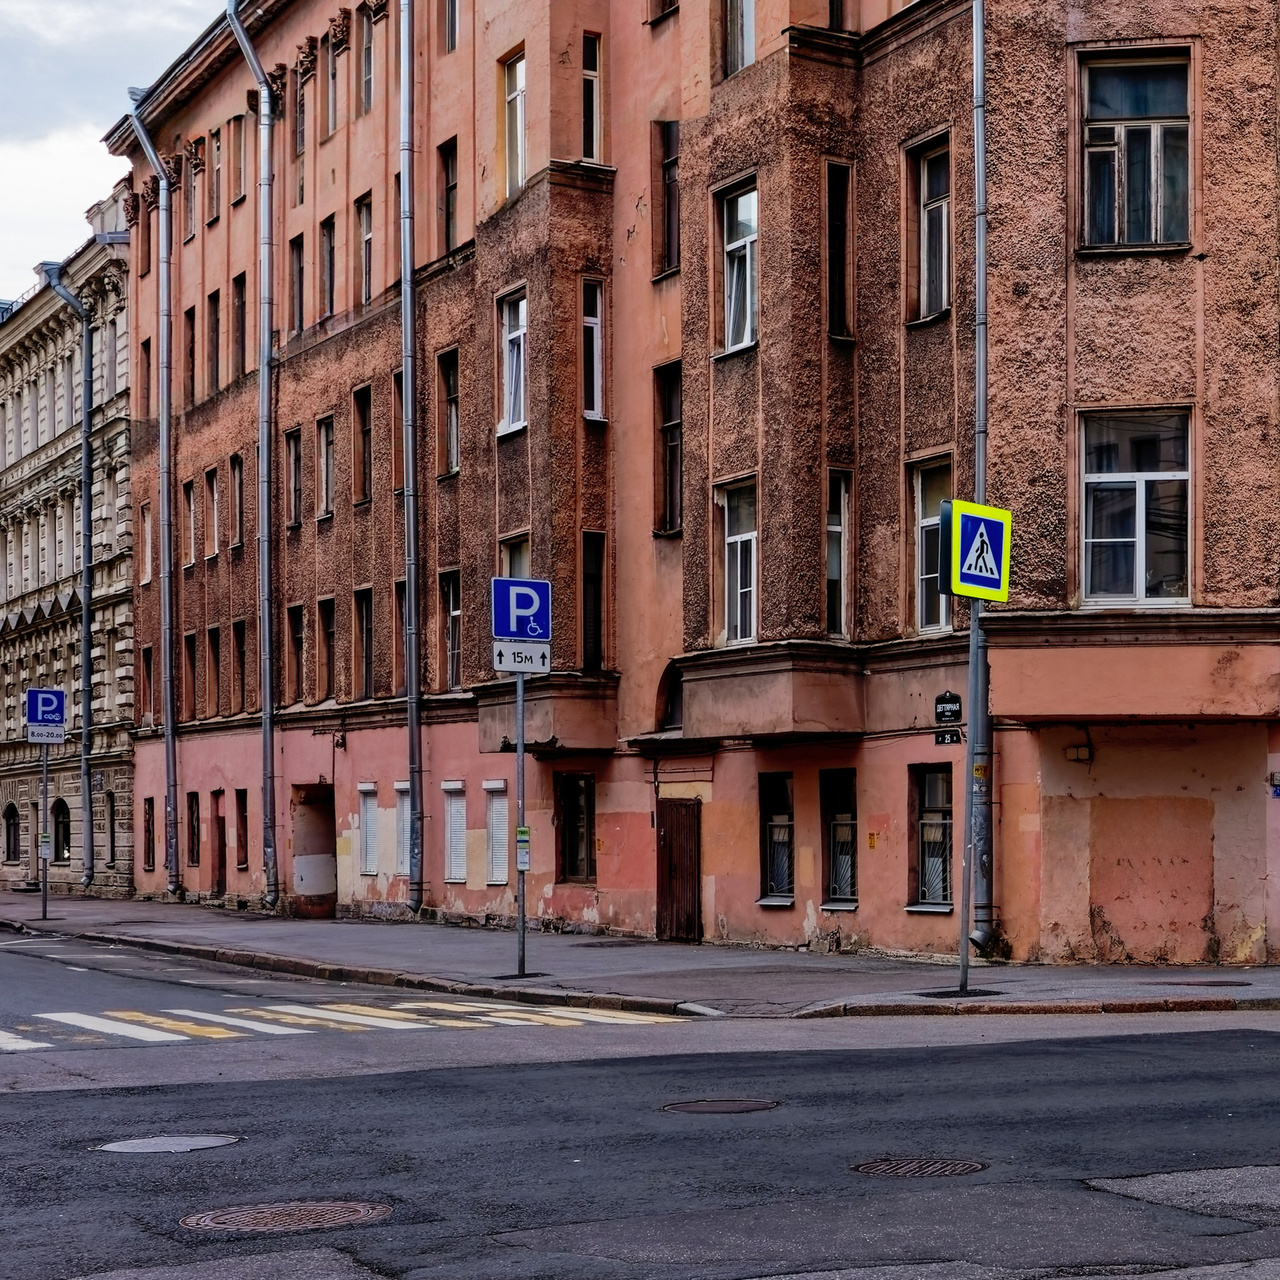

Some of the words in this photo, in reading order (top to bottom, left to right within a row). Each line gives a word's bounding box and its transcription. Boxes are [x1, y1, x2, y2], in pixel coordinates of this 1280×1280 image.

[509, 586, 540, 632] P
[37, 693, 58, 720] P
[30, 730, 63, 739] 8.00-20.00
[944, 734, 951, 743] 25
